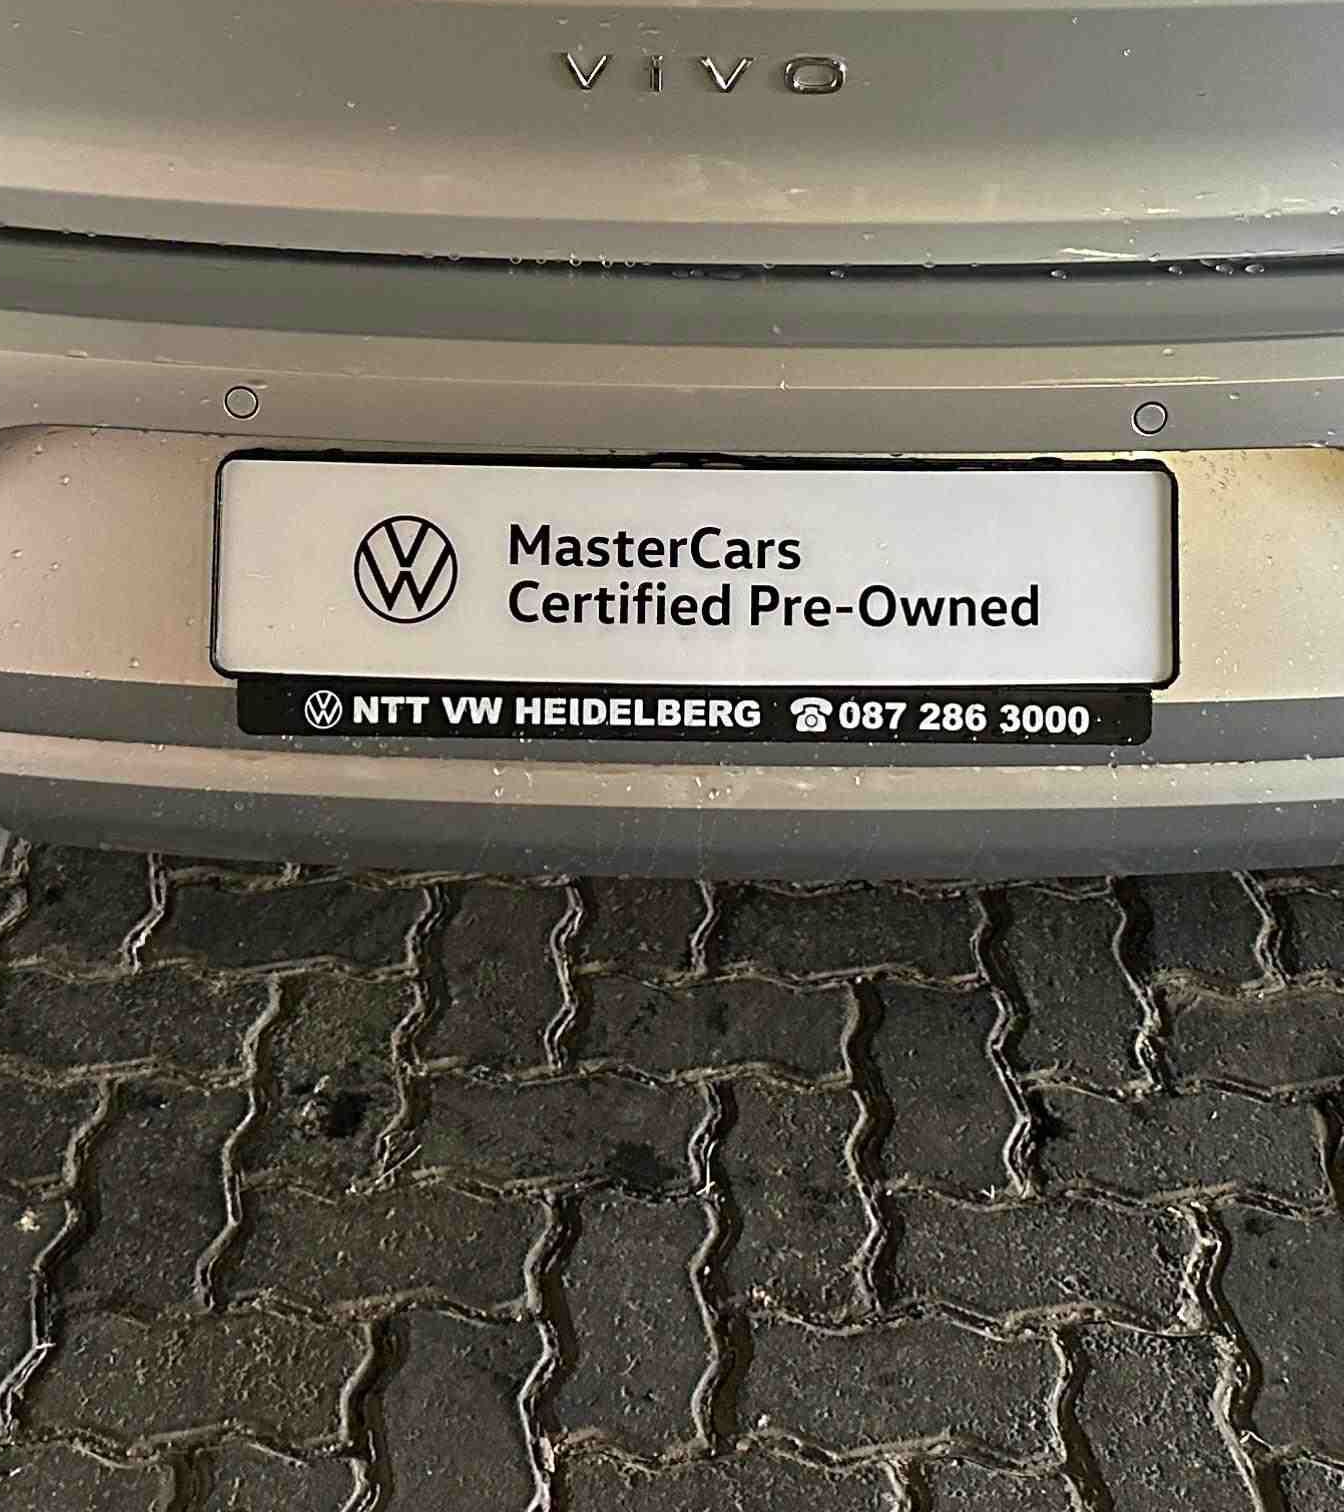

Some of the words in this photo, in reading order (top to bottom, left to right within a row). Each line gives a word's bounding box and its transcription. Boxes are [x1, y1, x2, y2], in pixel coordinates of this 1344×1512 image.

[509, 523, 801, 570] MasterCars
[508, 580, 731, 626] Certified
[750, 584, 1039, 627] Pre-Owned
[353, 696, 429, 724] NTT
[441, 697, 503, 724] VW
[515, 697, 761, 728] HEIDELBERG
[838, 701, 907, 729] 087
[919, 702, 987, 731] 286
[999, 704, 1089, 734] 3000
